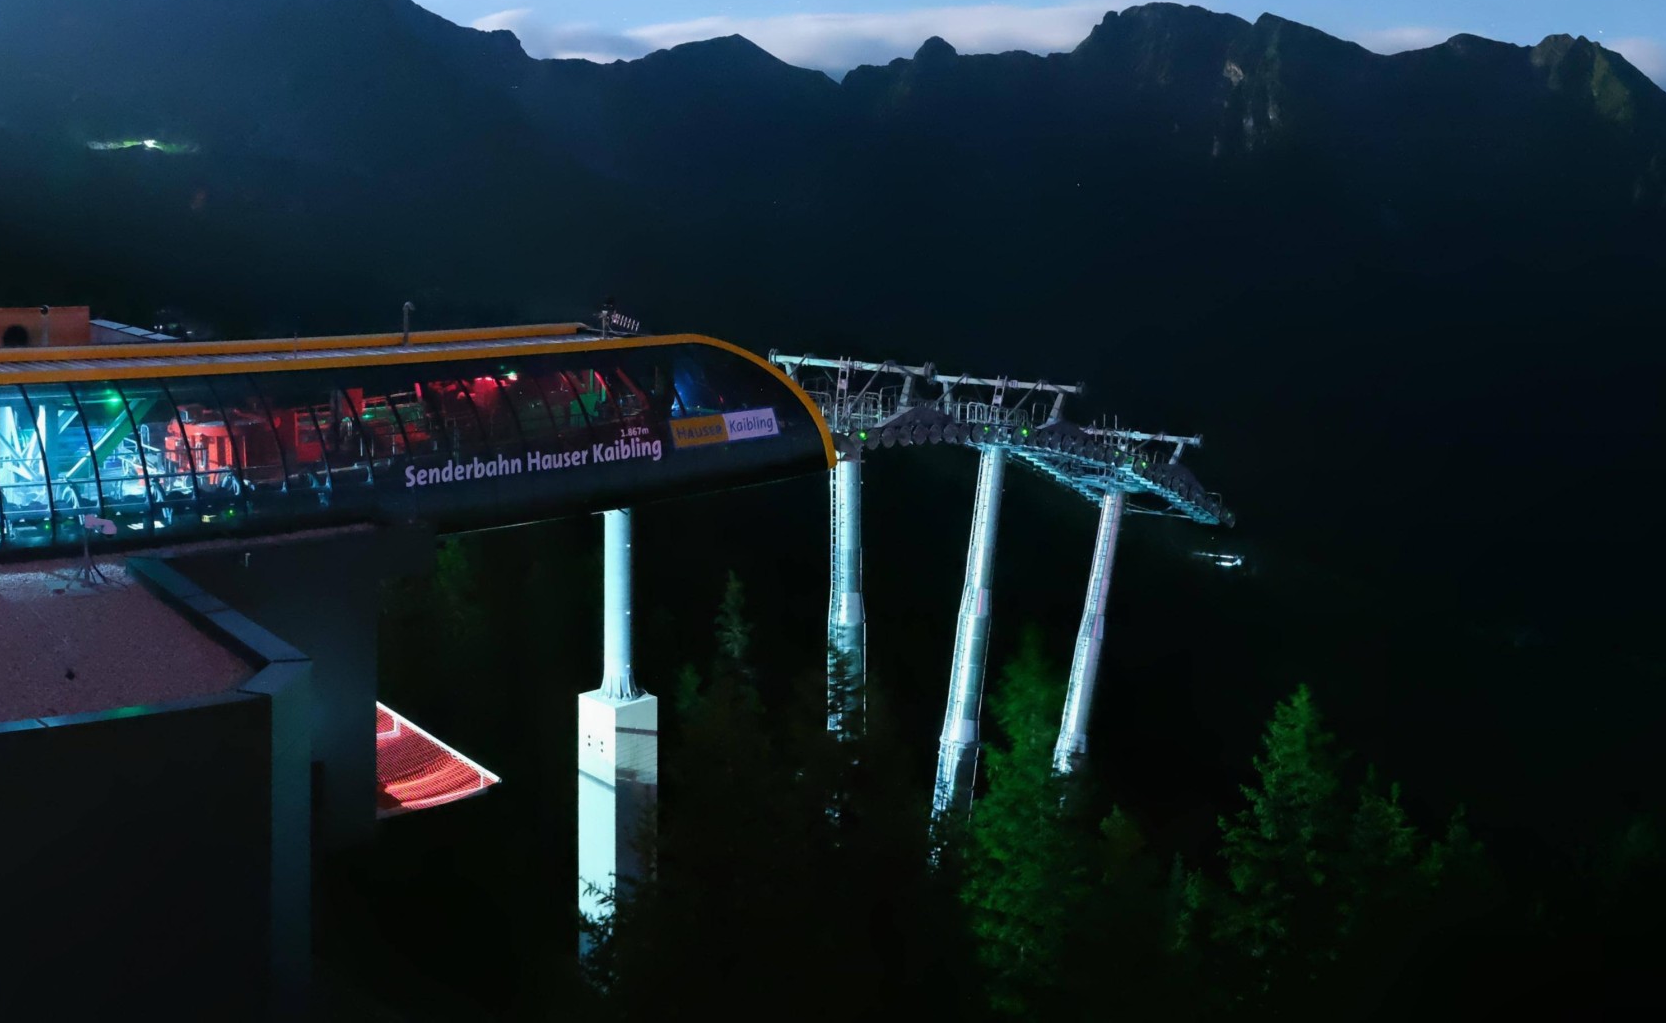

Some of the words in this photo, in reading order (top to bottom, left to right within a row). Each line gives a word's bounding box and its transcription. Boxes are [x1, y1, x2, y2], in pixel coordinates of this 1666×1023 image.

[729, 417, 773, 433] Kaibling
[404, 453, 522, 488] Senderbahn
[527, 449, 588, 473] Hauser
[593, 437, 662, 463] Kaibling
